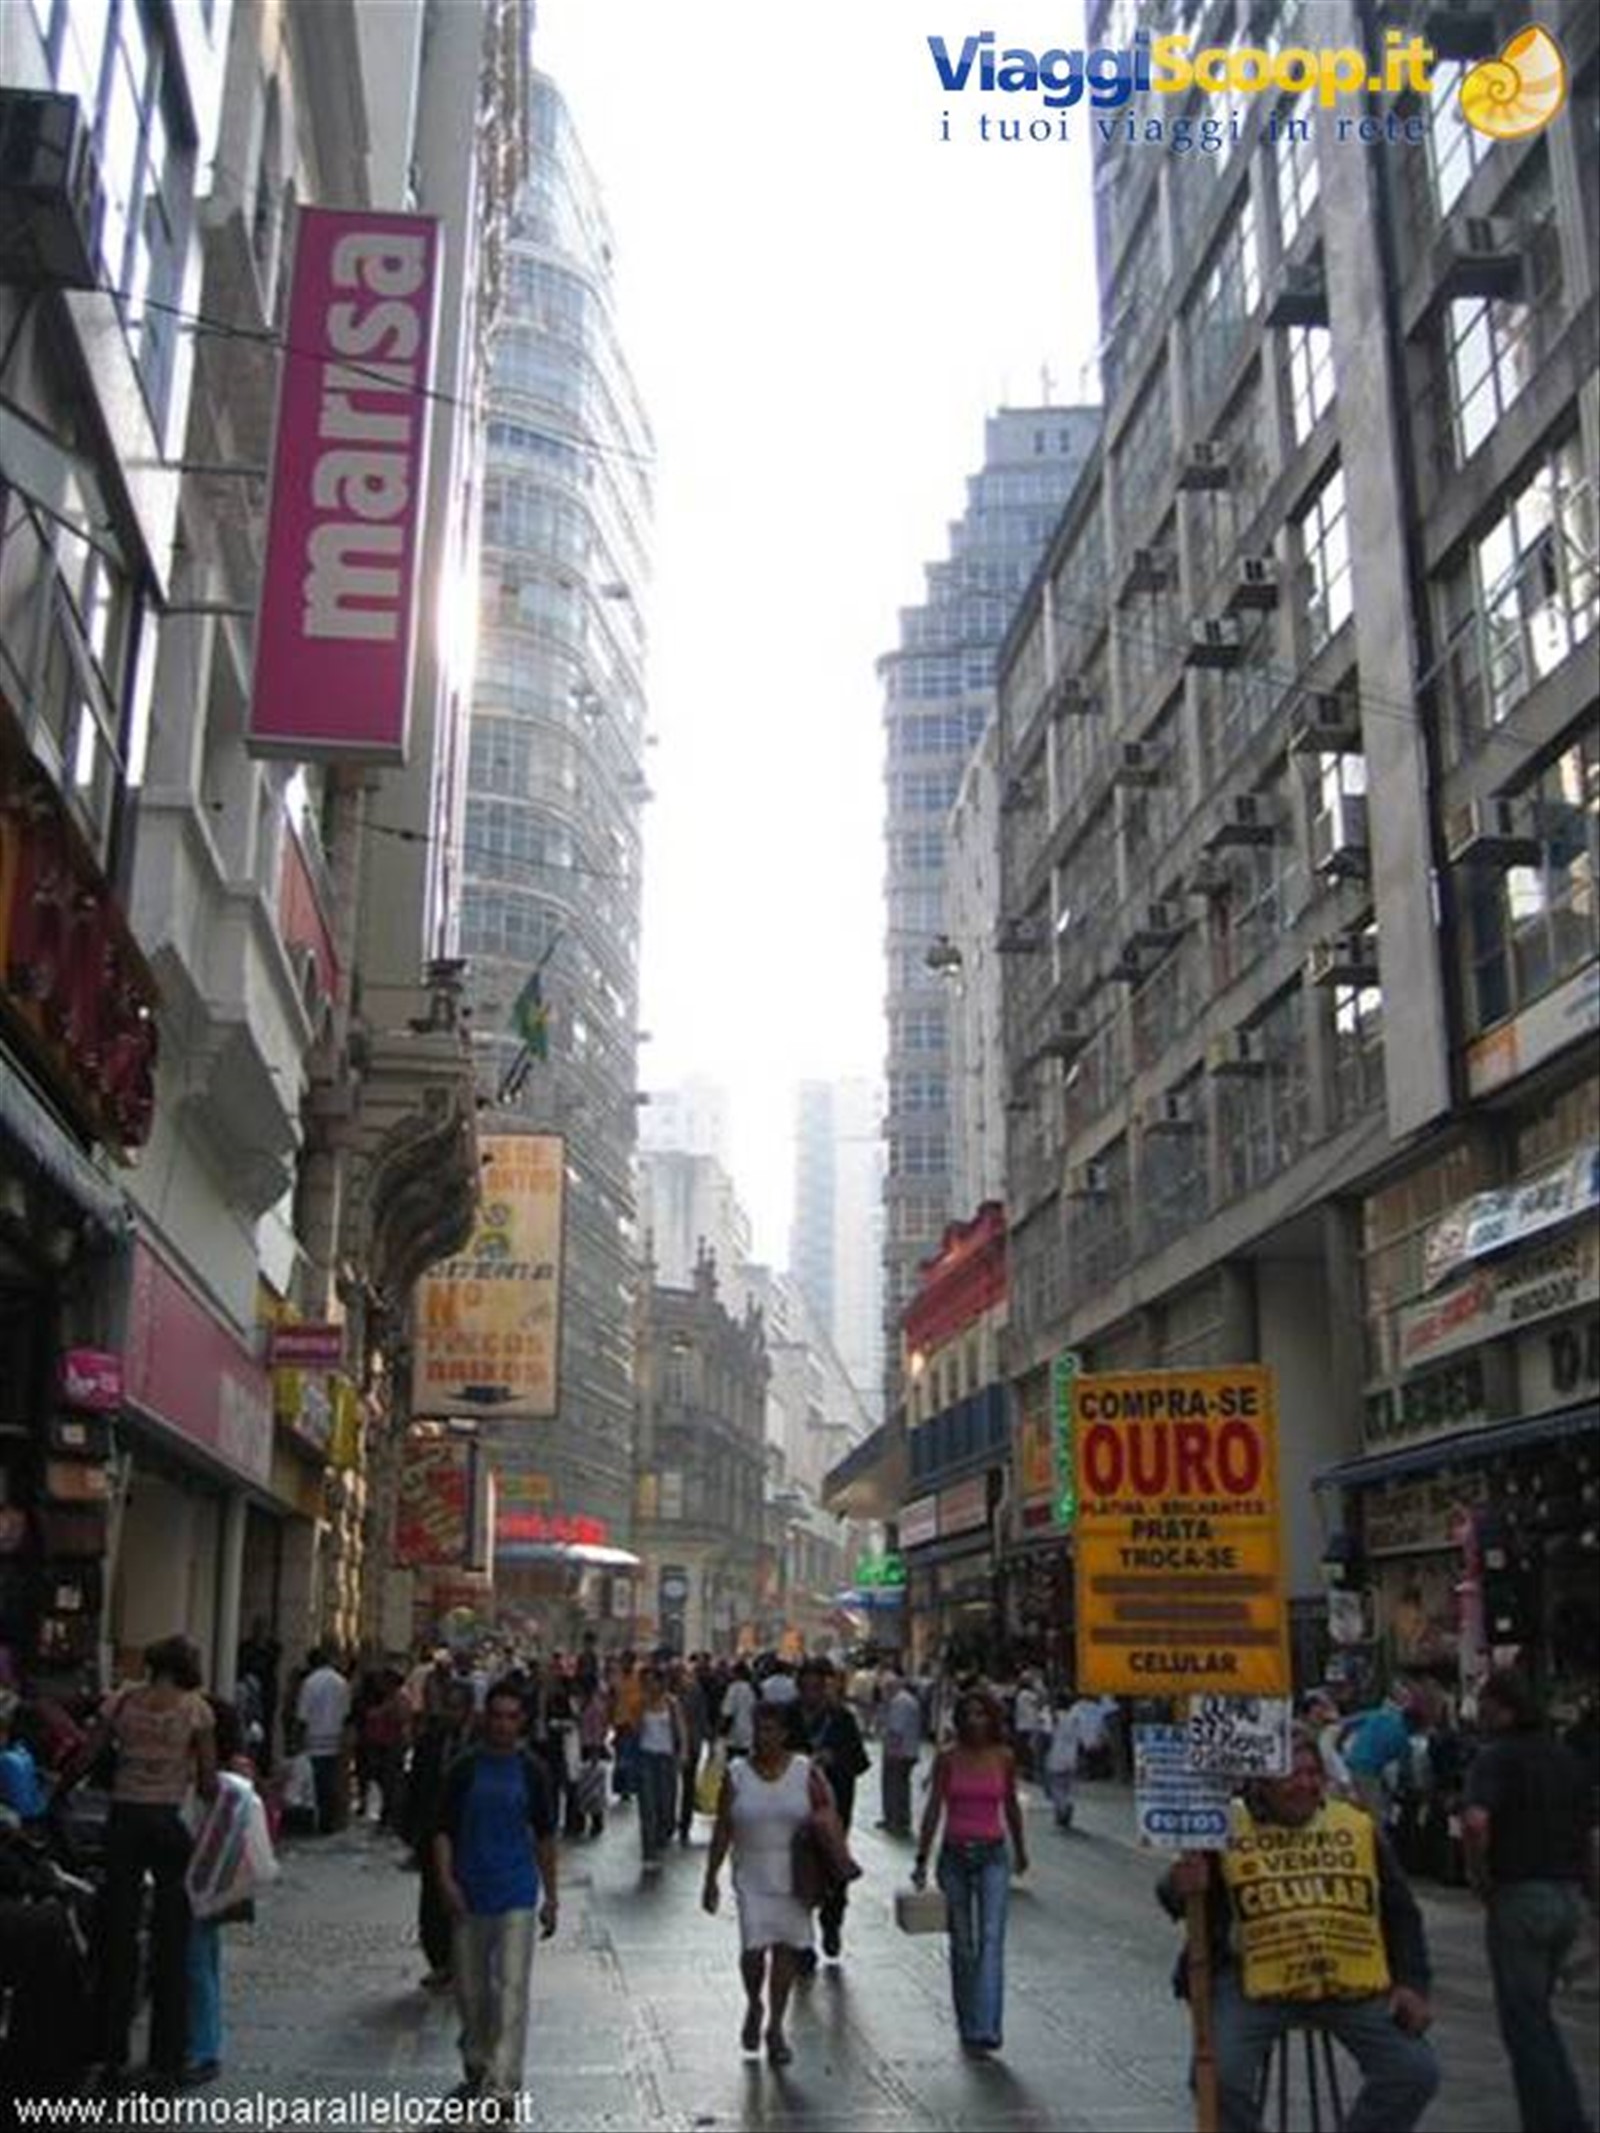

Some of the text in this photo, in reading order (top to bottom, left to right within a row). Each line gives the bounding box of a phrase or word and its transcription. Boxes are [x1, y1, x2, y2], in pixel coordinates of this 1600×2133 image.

[303, 231, 428, 640] marisa
[1079, 1386, 1258, 1420] COMPRA-SE
[1083, 1419, 1262, 1496] OURO
[1128, 1652, 1238, 1675] CELULAR
[1240, 1879, 1371, 1914] CELULAR
